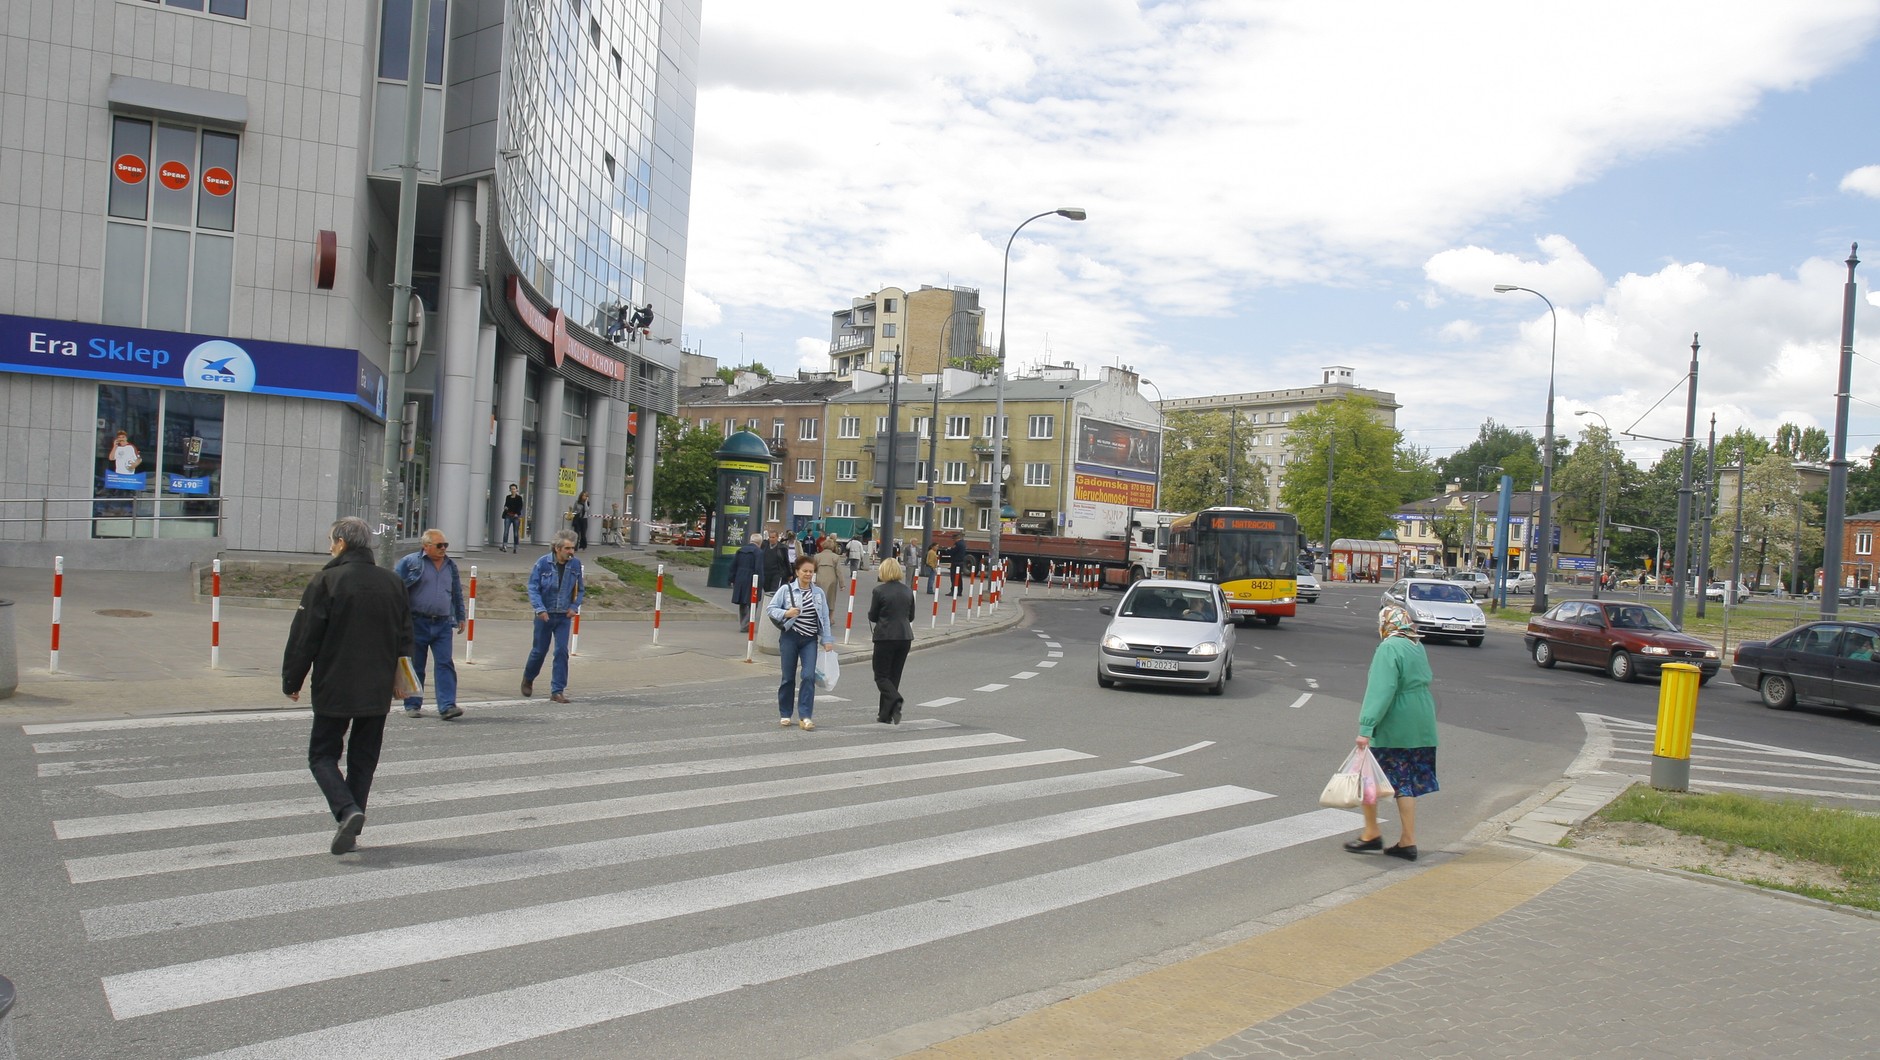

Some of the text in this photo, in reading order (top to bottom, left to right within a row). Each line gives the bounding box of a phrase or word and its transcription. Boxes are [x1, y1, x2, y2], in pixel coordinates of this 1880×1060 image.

[118, 163, 143, 173] SPEAK
[162, 169, 186, 180] SPEAK
[206, 175, 230, 186] SPEAK
[29, 332, 170, 369] Era Sklep
[568, 337, 618, 378] ENGLISH SCHOOL
[201, 373, 236, 384] era
[1076, 475, 1128, 490] Gadomska
[1211, 518, 1226, 529] 145
[1251, 580, 1273, 590] 8423
[1154, 661, 1177, 670] 20234
